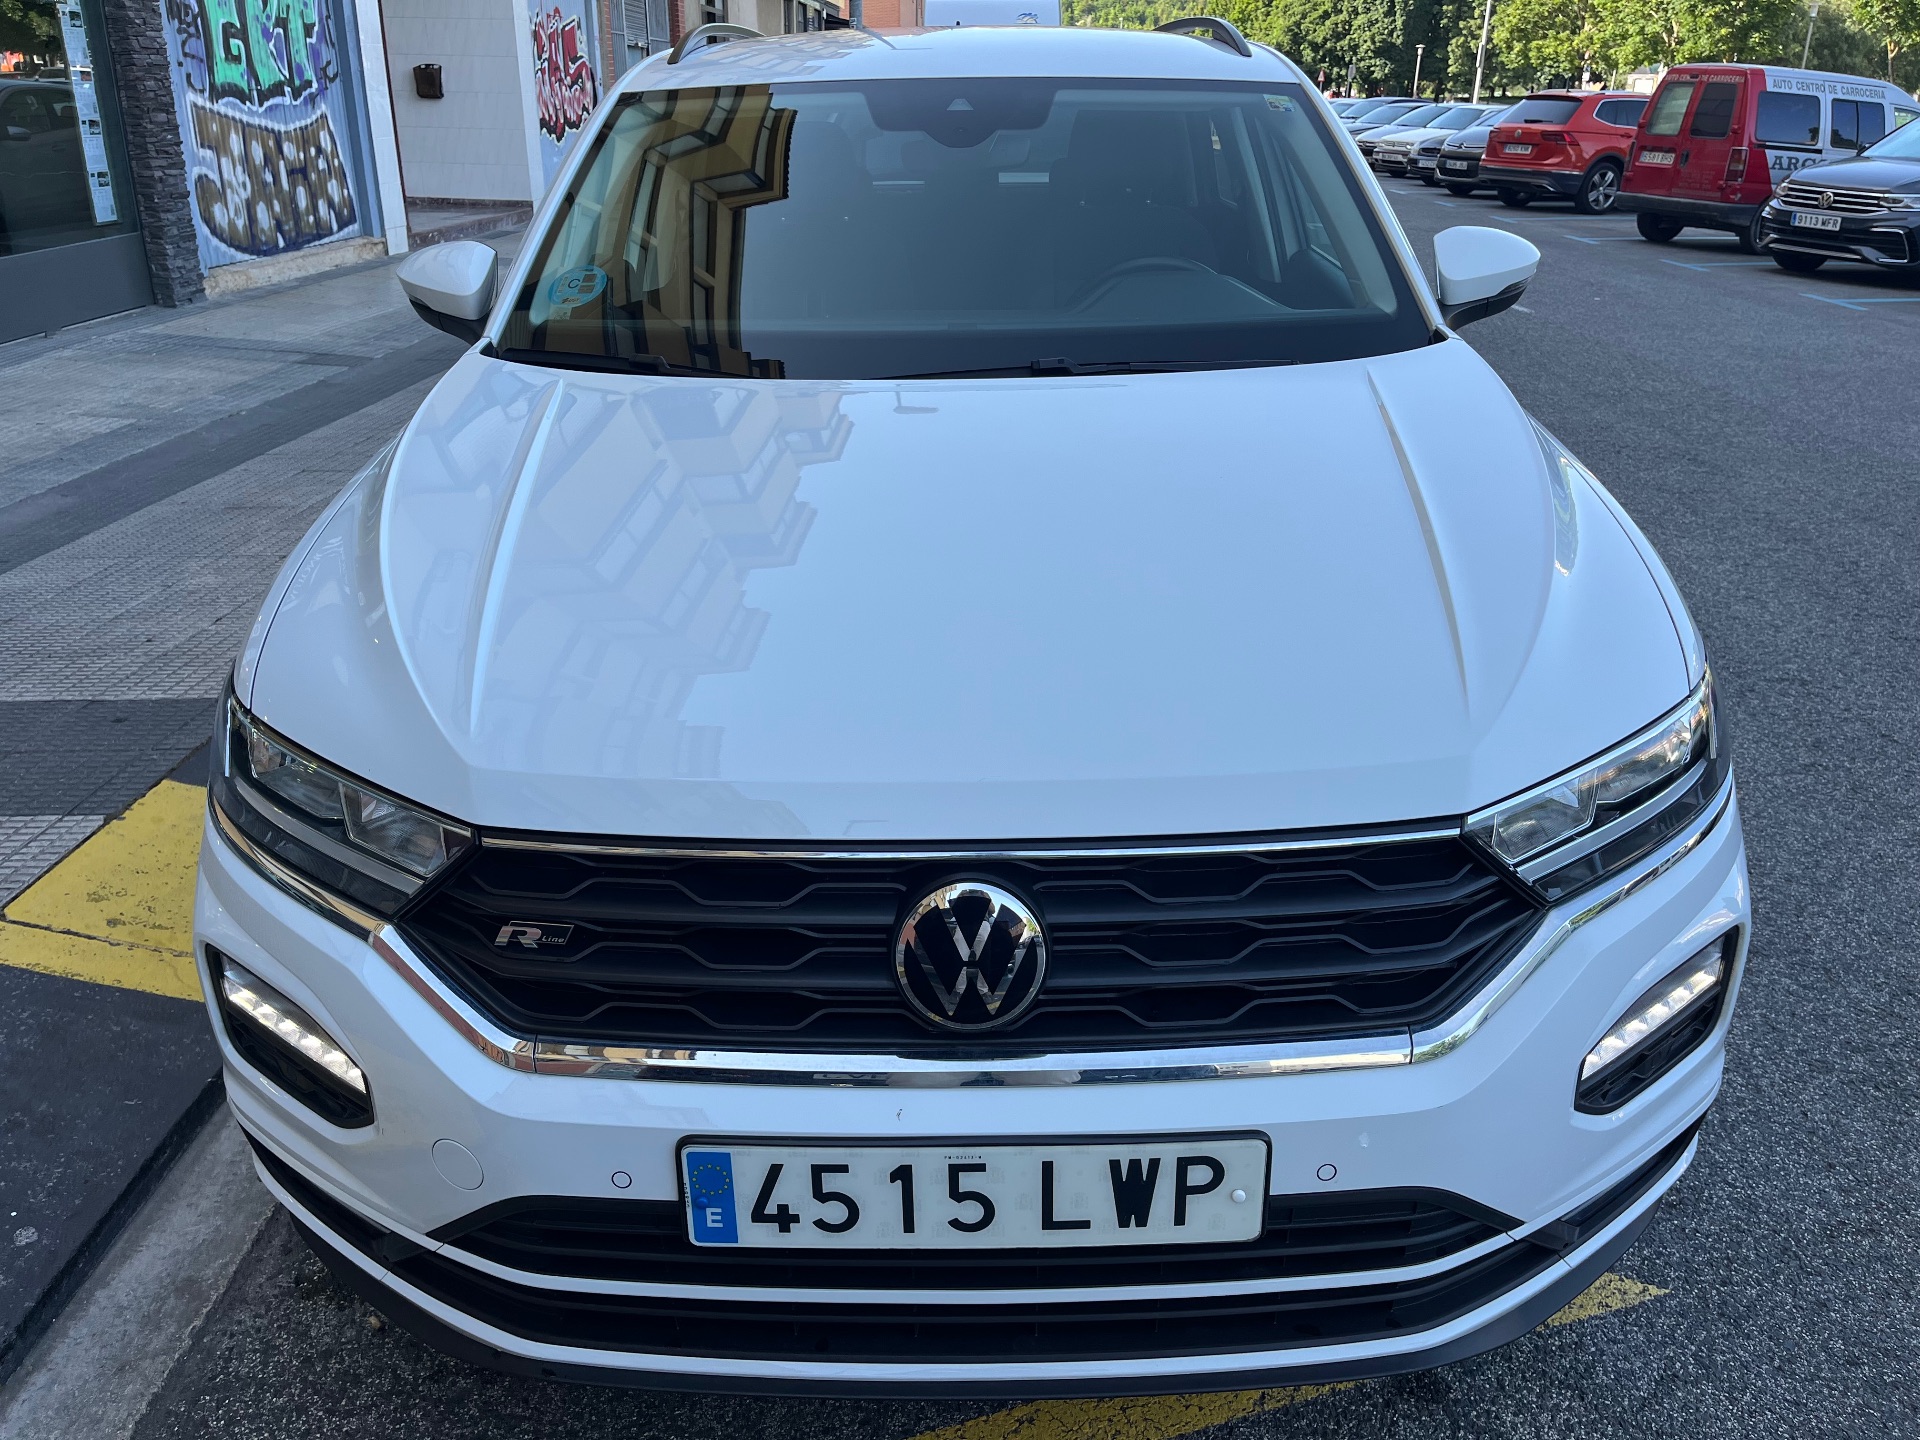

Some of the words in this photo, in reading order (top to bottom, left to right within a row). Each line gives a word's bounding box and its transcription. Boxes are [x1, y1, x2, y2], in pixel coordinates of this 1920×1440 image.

[1773, 79, 1792, 90] AUTO
[1796, 81, 1825, 93] CENTRO
[1828, 84, 1838, 94] DE
[1841, 86, 1886, 100] CARROCERIA
[1797, 215, 1819, 226] 9113
[750, 1163, 996, 1234] 4515
[1042, 1155, 1226, 1231] LWP
[706, 1208, 723, 1227] E
